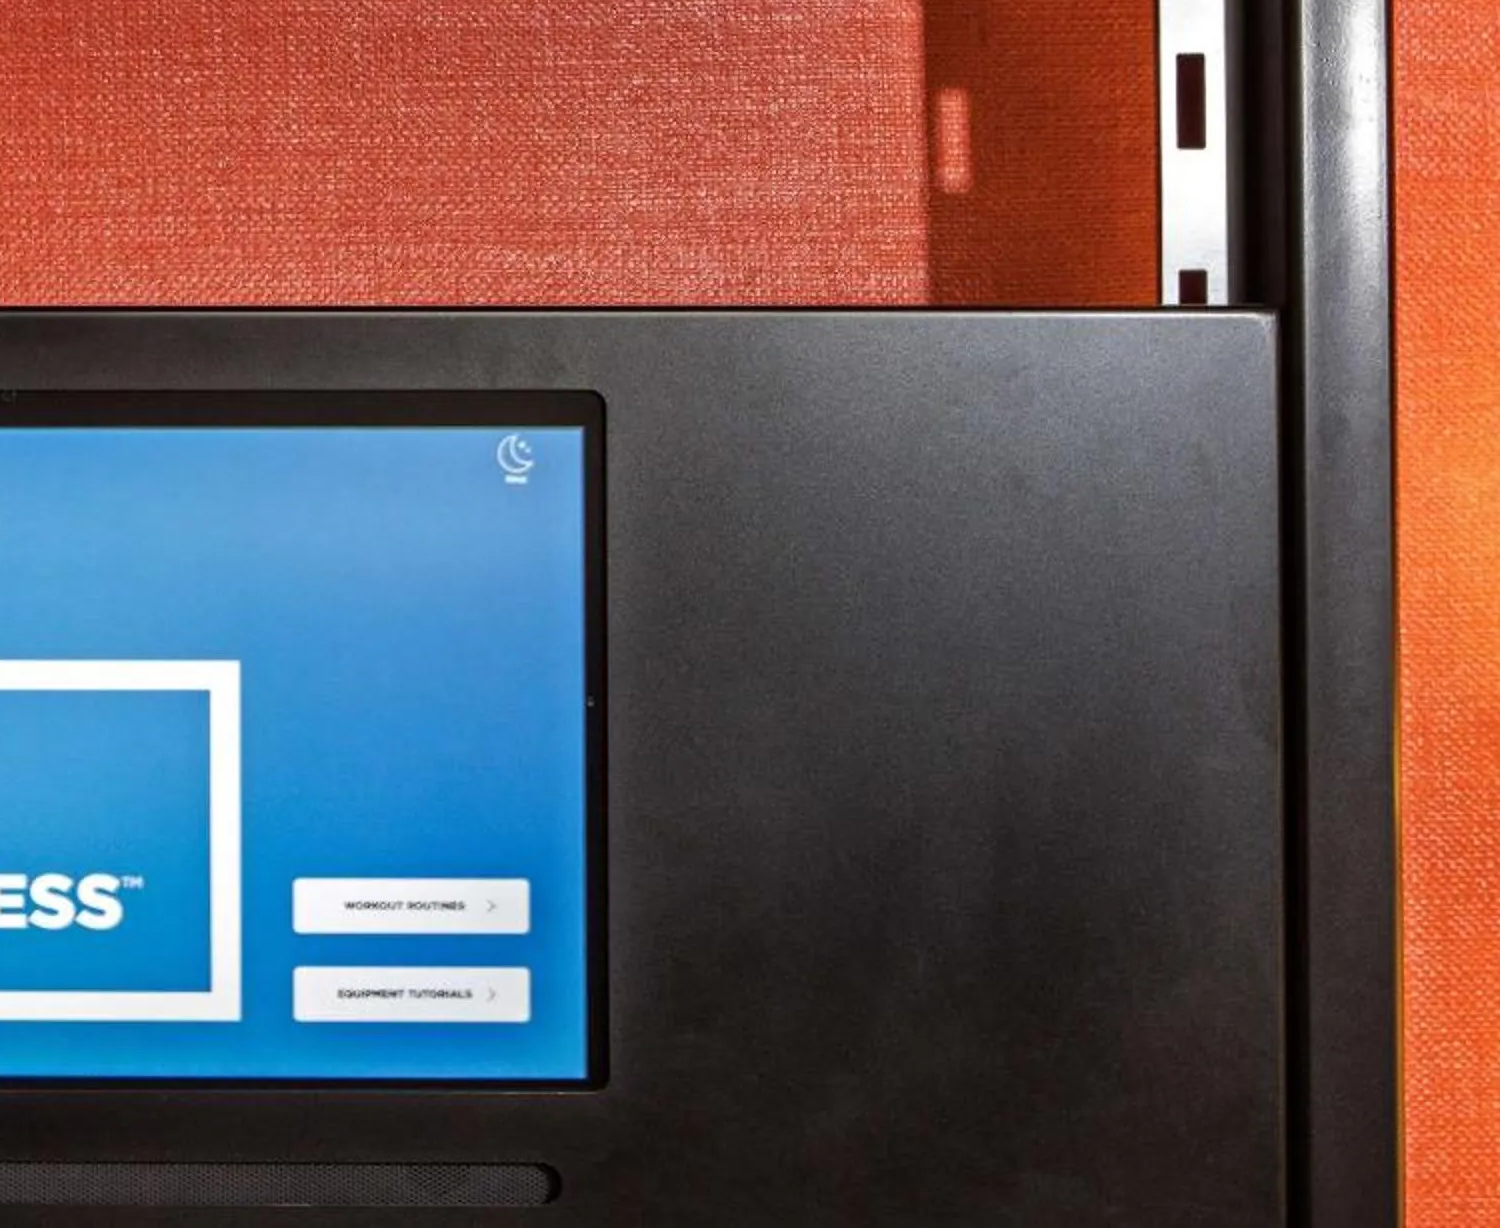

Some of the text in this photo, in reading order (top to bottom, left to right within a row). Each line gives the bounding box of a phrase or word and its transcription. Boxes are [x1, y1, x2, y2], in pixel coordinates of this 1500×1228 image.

[343, 900, 467, 911] WORKOUT ROUTINES
[336, 988, 474, 1000] EQUIPMENT TUTORIALS
